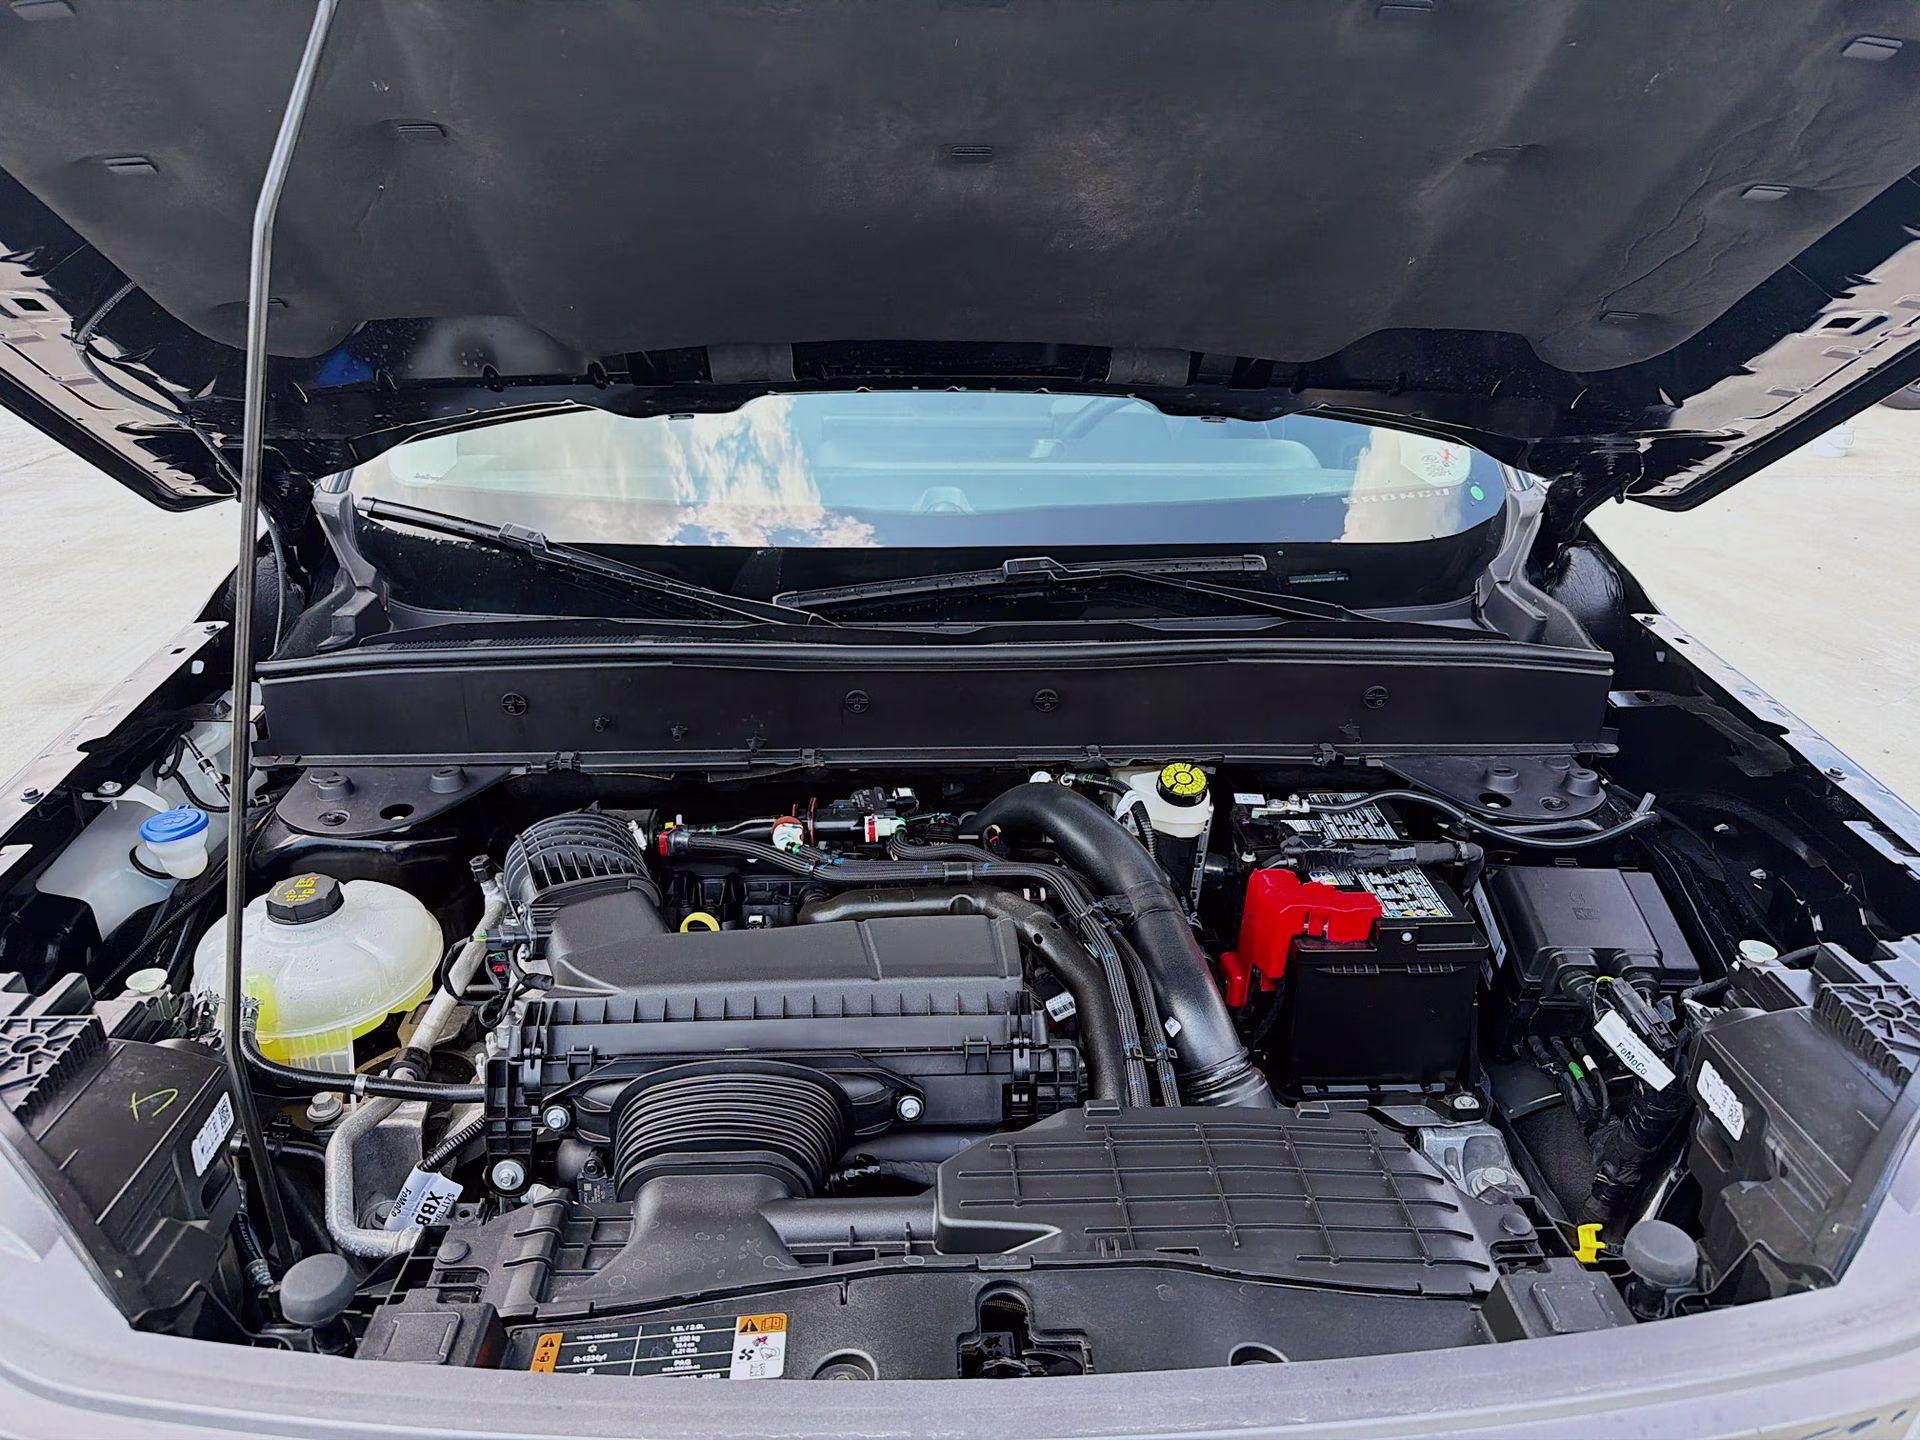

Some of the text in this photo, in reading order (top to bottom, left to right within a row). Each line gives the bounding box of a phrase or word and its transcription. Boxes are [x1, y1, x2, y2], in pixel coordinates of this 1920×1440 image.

[1616, 1042, 1647, 1075] FoMoCo
[391, 1186, 412, 1217] FoMoCo
[415, 1190, 444, 1225] XBB
